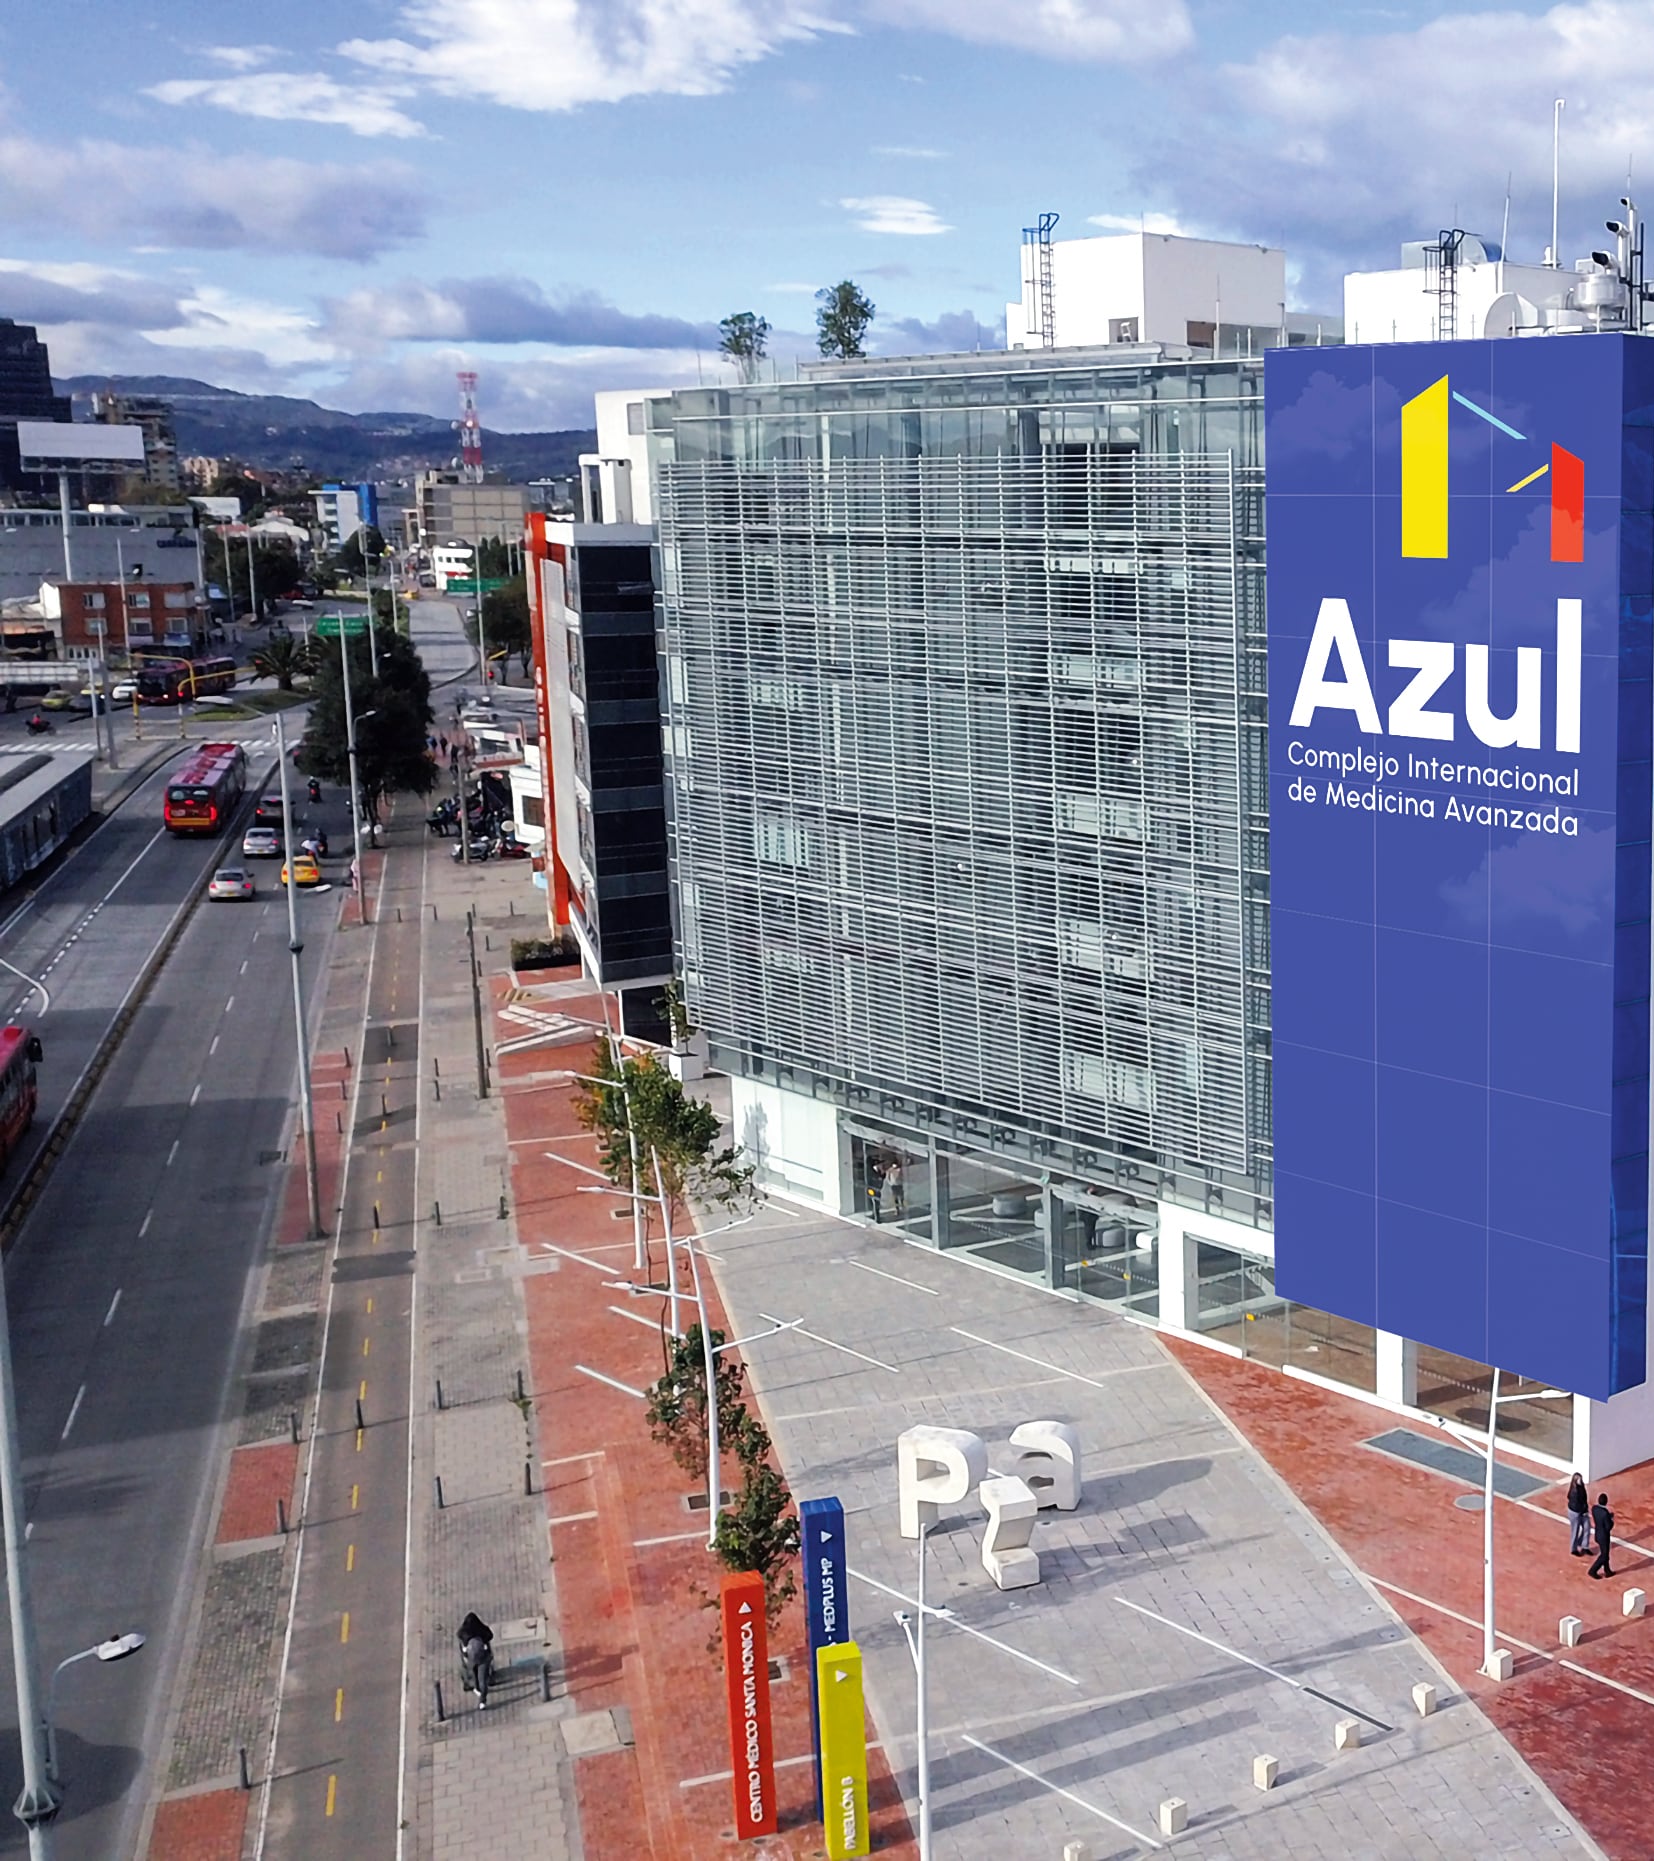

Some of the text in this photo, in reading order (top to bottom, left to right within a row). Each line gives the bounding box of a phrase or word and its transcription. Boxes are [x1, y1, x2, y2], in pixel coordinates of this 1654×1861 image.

[1288, 597, 1582, 754] Azul
[1287, 741, 1579, 797] Complejo Internacional
[1288, 776, 1579, 837] de Medicina Avanzada
[820, 1557, 834, 1576] MP
[822, 1577, 837, 1633] MEDPLUS
[743, 1675, 757, 1719] SANTA
[748, 1770, 763, 1823] CENTRO
